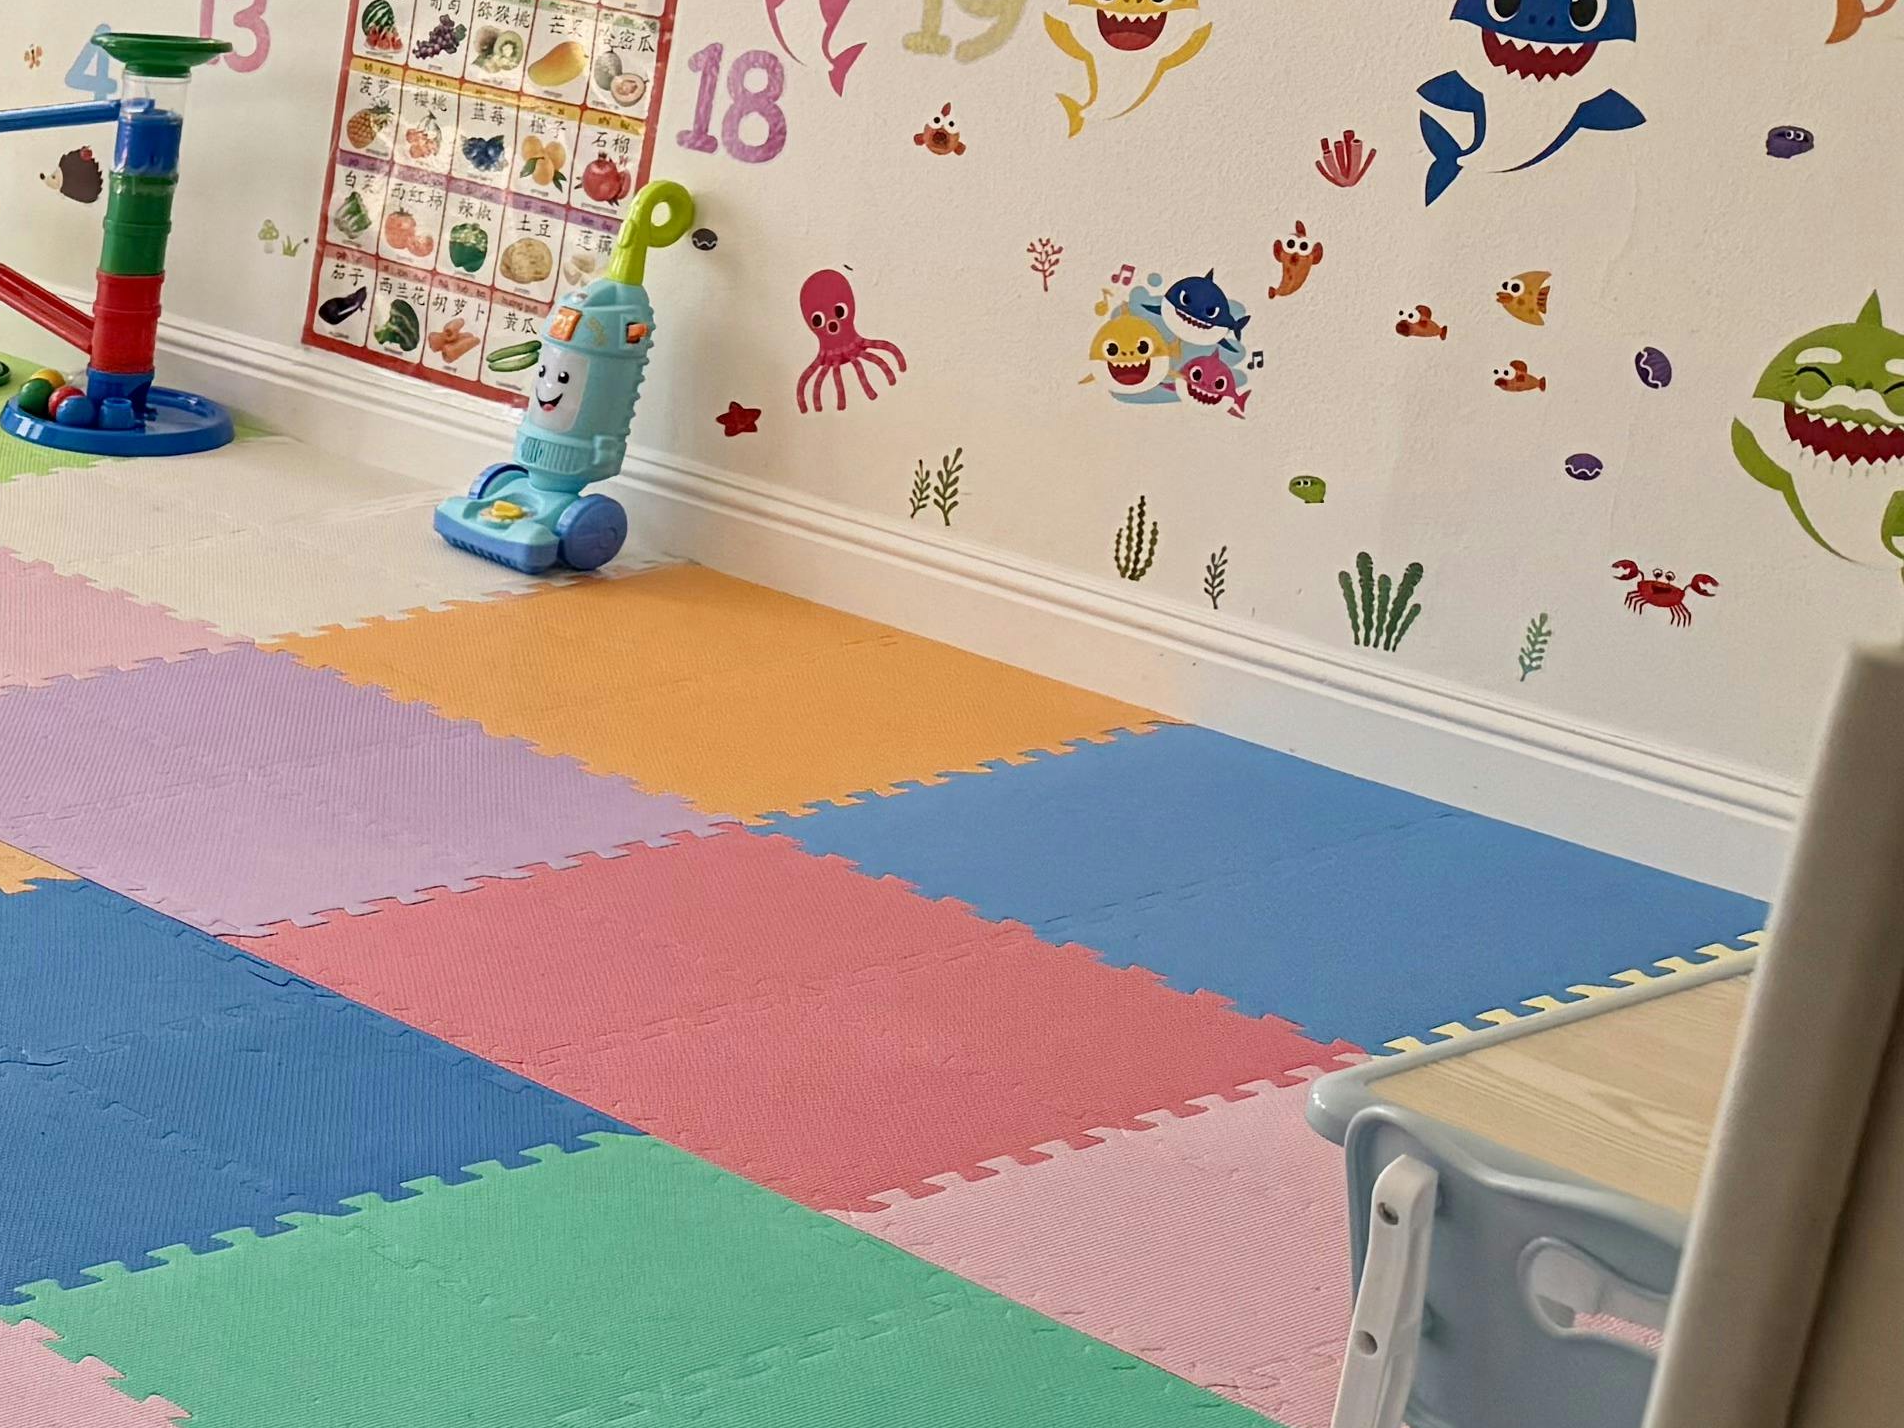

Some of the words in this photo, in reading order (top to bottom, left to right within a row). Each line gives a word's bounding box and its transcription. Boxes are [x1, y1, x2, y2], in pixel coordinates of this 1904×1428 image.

[64, 23, 118, 101] 4
[471, 102, 505, 126] 蓝莓
[676, 43, 786, 163] 18
[592, 131, 630, 154] 石榴
[516, 214, 551, 238] 土豆
[331, 263, 364, 286] 茄子
[379, 277, 425, 306] 西兰花
[432, 293, 485, 322] 胡萝卜
[504, 313, 537, 335] 黄瓜
